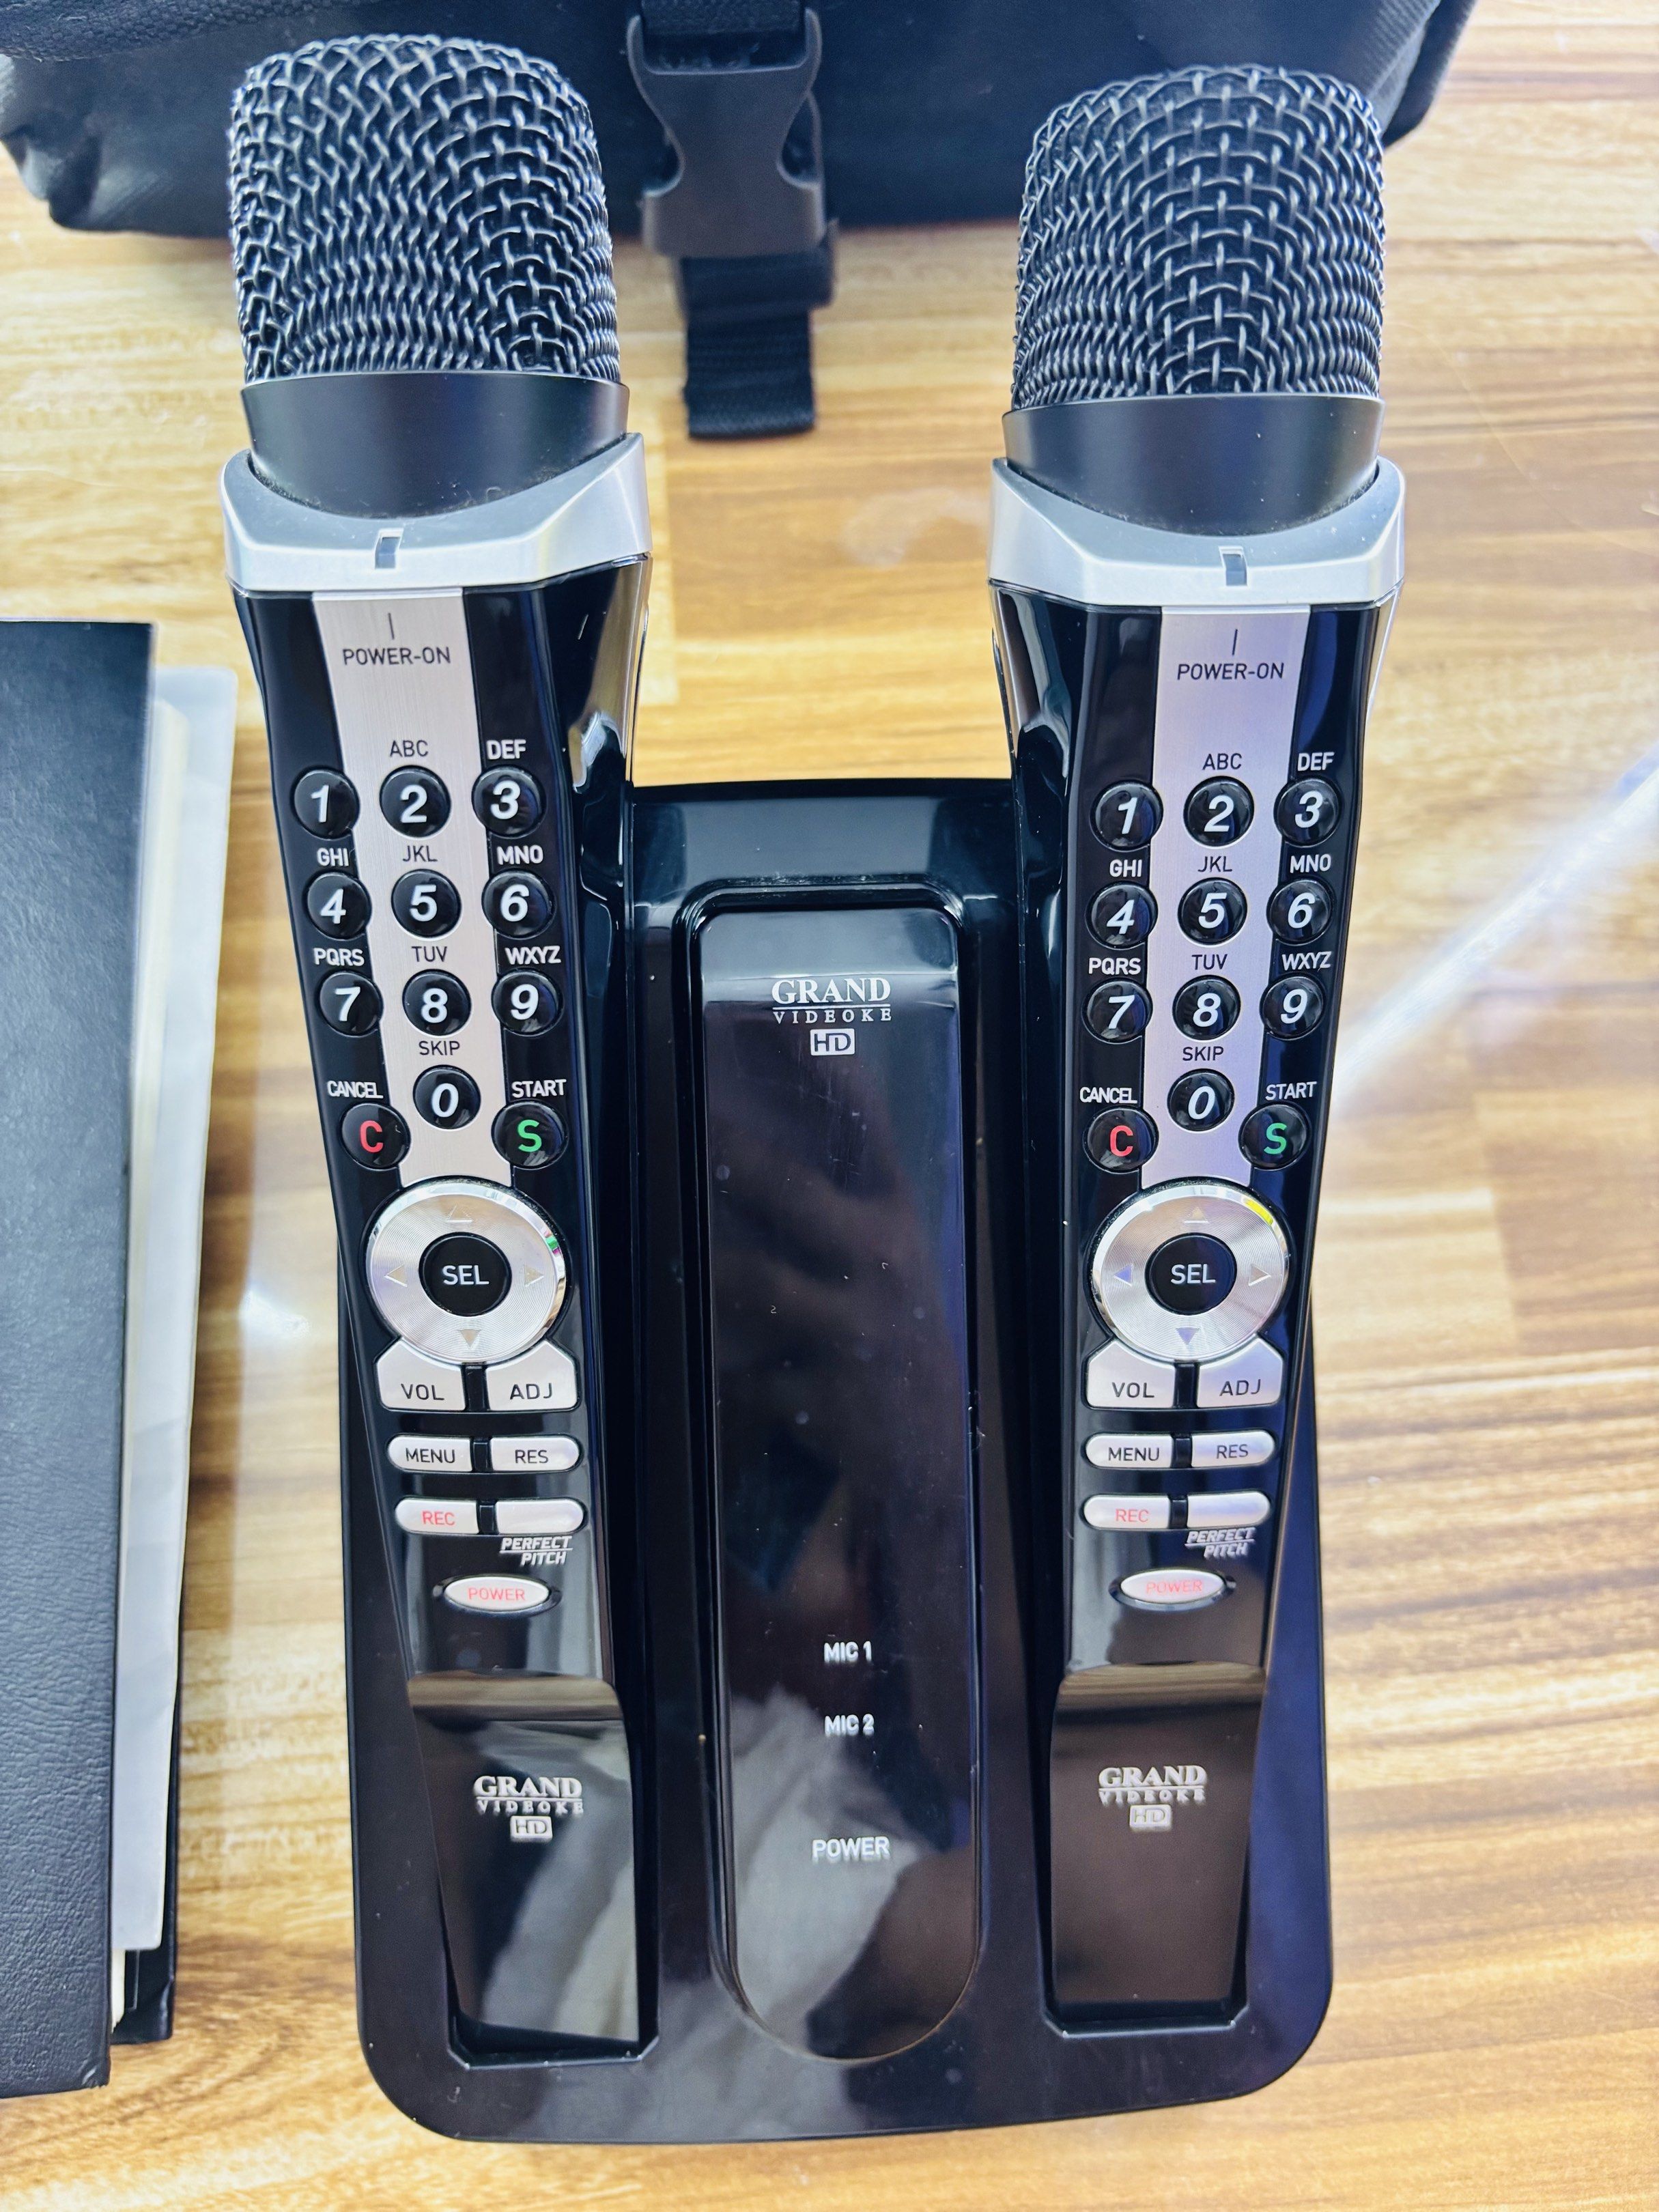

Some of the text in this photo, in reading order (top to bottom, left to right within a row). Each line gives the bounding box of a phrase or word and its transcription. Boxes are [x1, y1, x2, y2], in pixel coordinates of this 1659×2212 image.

[343, 646, 451, 666] POWER-ON
[1177, 662, 1284, 680] POWER-ON
[390, 740, 428, 757] ABC
[486, 739, 526, 759] DEF
[1202, 753, 1243, 771] ABC
[1297, 752, 1334, 771] DEF
[311, 784, 329, 823] 1
[399, 784, 428, 823] 2
[490, 780, 520, 819] 3
[1118, 797, 1137, 834] 1
[1204, 795, 1234, 832] 2
[1294, 791, 1323, 828] 3
[317, 848, 349, 867] GHI
[402, 845, 438, 862] JKL
[496, 845, 543, 865] MNO
[1290, 853, 1331, 873] MNO
[1109, 859, 1142, 877] GHI
[1197, 856, 1233, 873] JKL
[320, 889, 345, 924] 4
[410, 883, 438, 922] 5
[500, 881, 529, 922] 6
[1198, 892, 1228, 928] 5
[1288, 893, 1315, 928] 6
[1107, 900, 1134, 935] 4
[313, 948, 365, 966] PQRS
[412, 946, 447, 963] TUV
[505, 946, 561, 965] WXYZ
[1192, 954, 1228, 970] TUV
[1281, 951, 1331, 972] WXYZ
[1088, 957, 1141, 976] PQRS
[771, 977, 891, 1004] GRAND
[335, 987, 360, 1021] 7
[421, 988, 449, 1023] 8
[510, 984, 539, 1020] 9
[1193, 993, 1221, 1027] 8
[1280, 989, 1308, 1024] 9
[773, 1008, 892, 1024] VIDEOKE
[1108, 995, 1135, 1029] 7
[419, 1040, 460, 1055] SKIP
[814, 1032, 851, 1051] HD
[1182, 1046, 1223, 1061] SKIP
[327, 1081, 383, 1098] CANCEL
[511, 1079, 567, 1098] START
[1080, 1087, 1137, 1104] CANCEL
[1266, 1081, 1316, 1101] START
[431, 1083, 459, 1118] 0
[1187, 1086, 1215, 1120] 0
[360, 1120, 384, 1153] C
[517, 1120, 542, 1152] S
[1109, 1125, 1133, 1157] C
[1263, 1123, 1287, 1154] S
[442, 1264, 489, 1286] SEL
[1171, 1264, 1216, 1284] SEL
[401, 1383, 444, 1400] VOL
[510, 1382, 553, 1400] ADJ
[1111, 1381, 1154, 1398] VOL
[1219, 1379, 1261, 1397] ADJ
[406, 1447, 455, 1464] MENU
[514, 1449, 549, 1464] RES
[1108, 1447, 1160, 1462] MENU
[1216, 1444, 1249, 1459] RES
[422, 1510, 455, 1526] REC
[1116, 1508, 1149, 1523] REC
[500, 1536, 572, 1552] PERFECT
[1187, 1527, 1256, 1544] PERFECT
[520, 1551, 567, 1566] PITCH
[1204, 1543, 1249, 1559] PITCH
[468, 1588, 525, 1602] POWER
[1146, 1578, 1203, 1594] POWER
[824, 1641, 872, 1662] MIC 1
[825, 1713, 875, 1735] MIC 2
[474, 1776, 582, 1796] GRAND
[1098, 1766, 1207, 1787] GRAND
[477, 1801, 583, 1815] VIDEOKE
[1133, 1809, 1166, 1824] HD
[515, 1819, 548, 1834] HD
[812, 1836, 890, 1862] POWER
